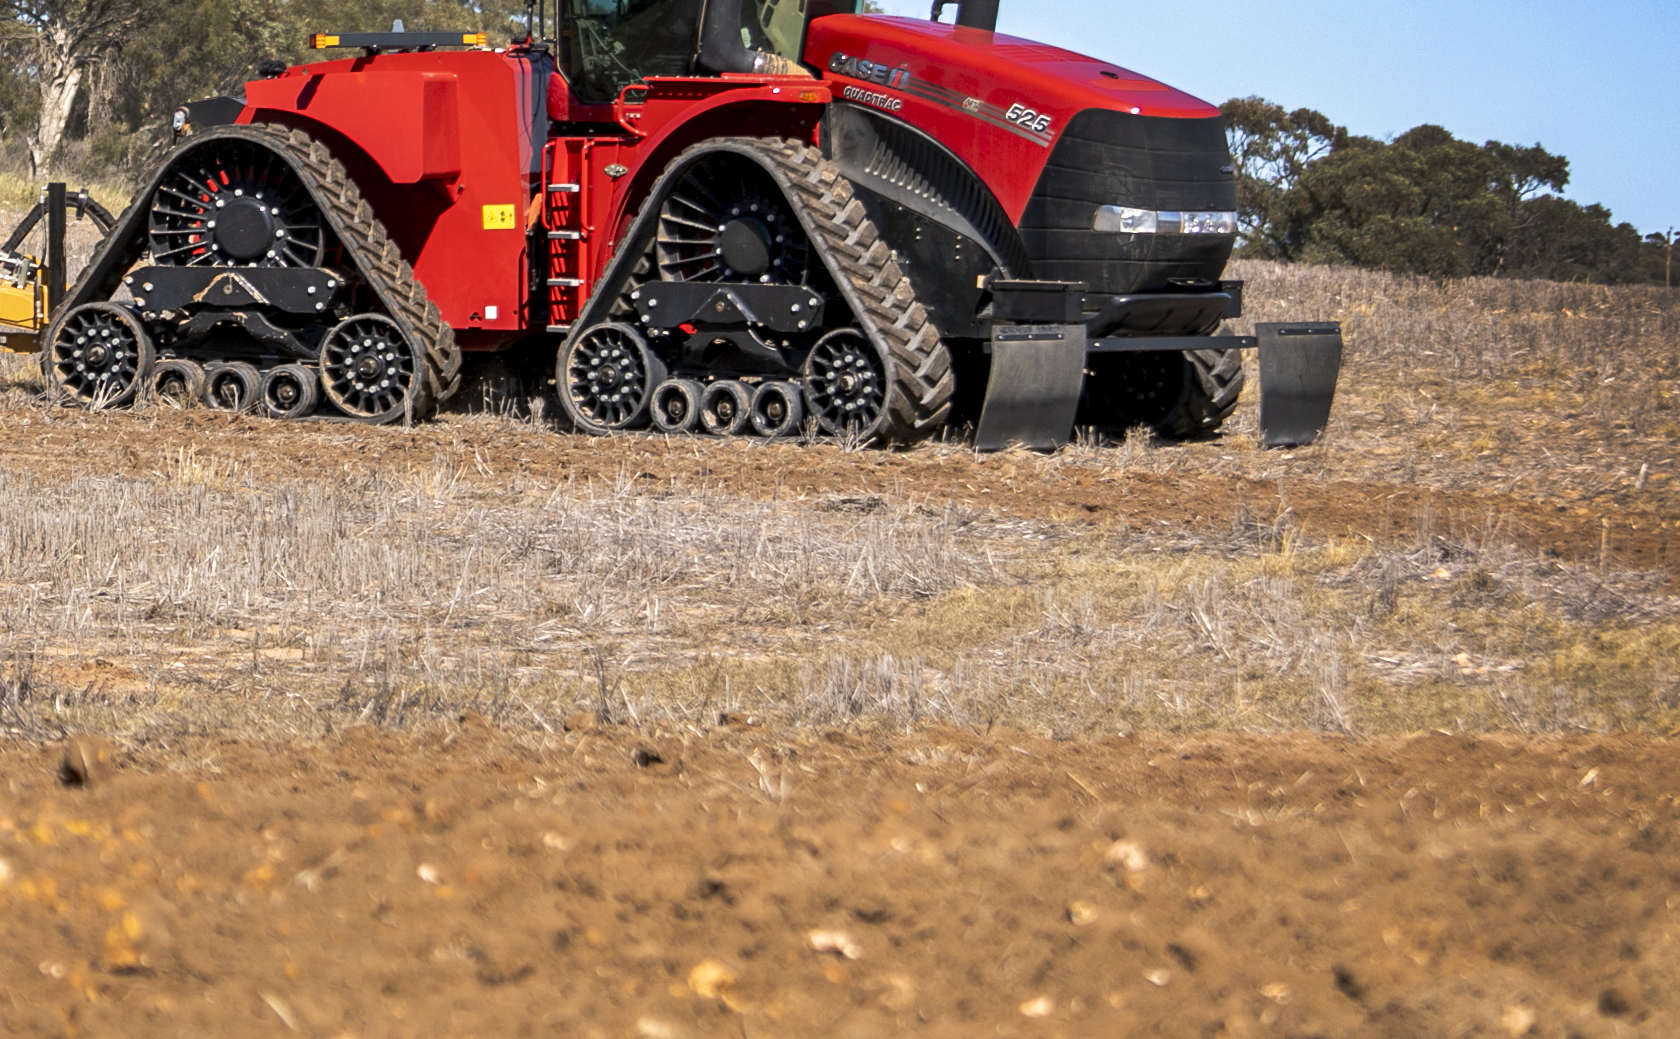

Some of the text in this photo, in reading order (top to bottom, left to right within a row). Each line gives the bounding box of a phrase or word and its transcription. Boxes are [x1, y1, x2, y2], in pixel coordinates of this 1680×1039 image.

[828, 51, 888, 83] CASE
[843, 85, 902, 111] QUADTRAC
[1005, 103, 1051, 133] 525
